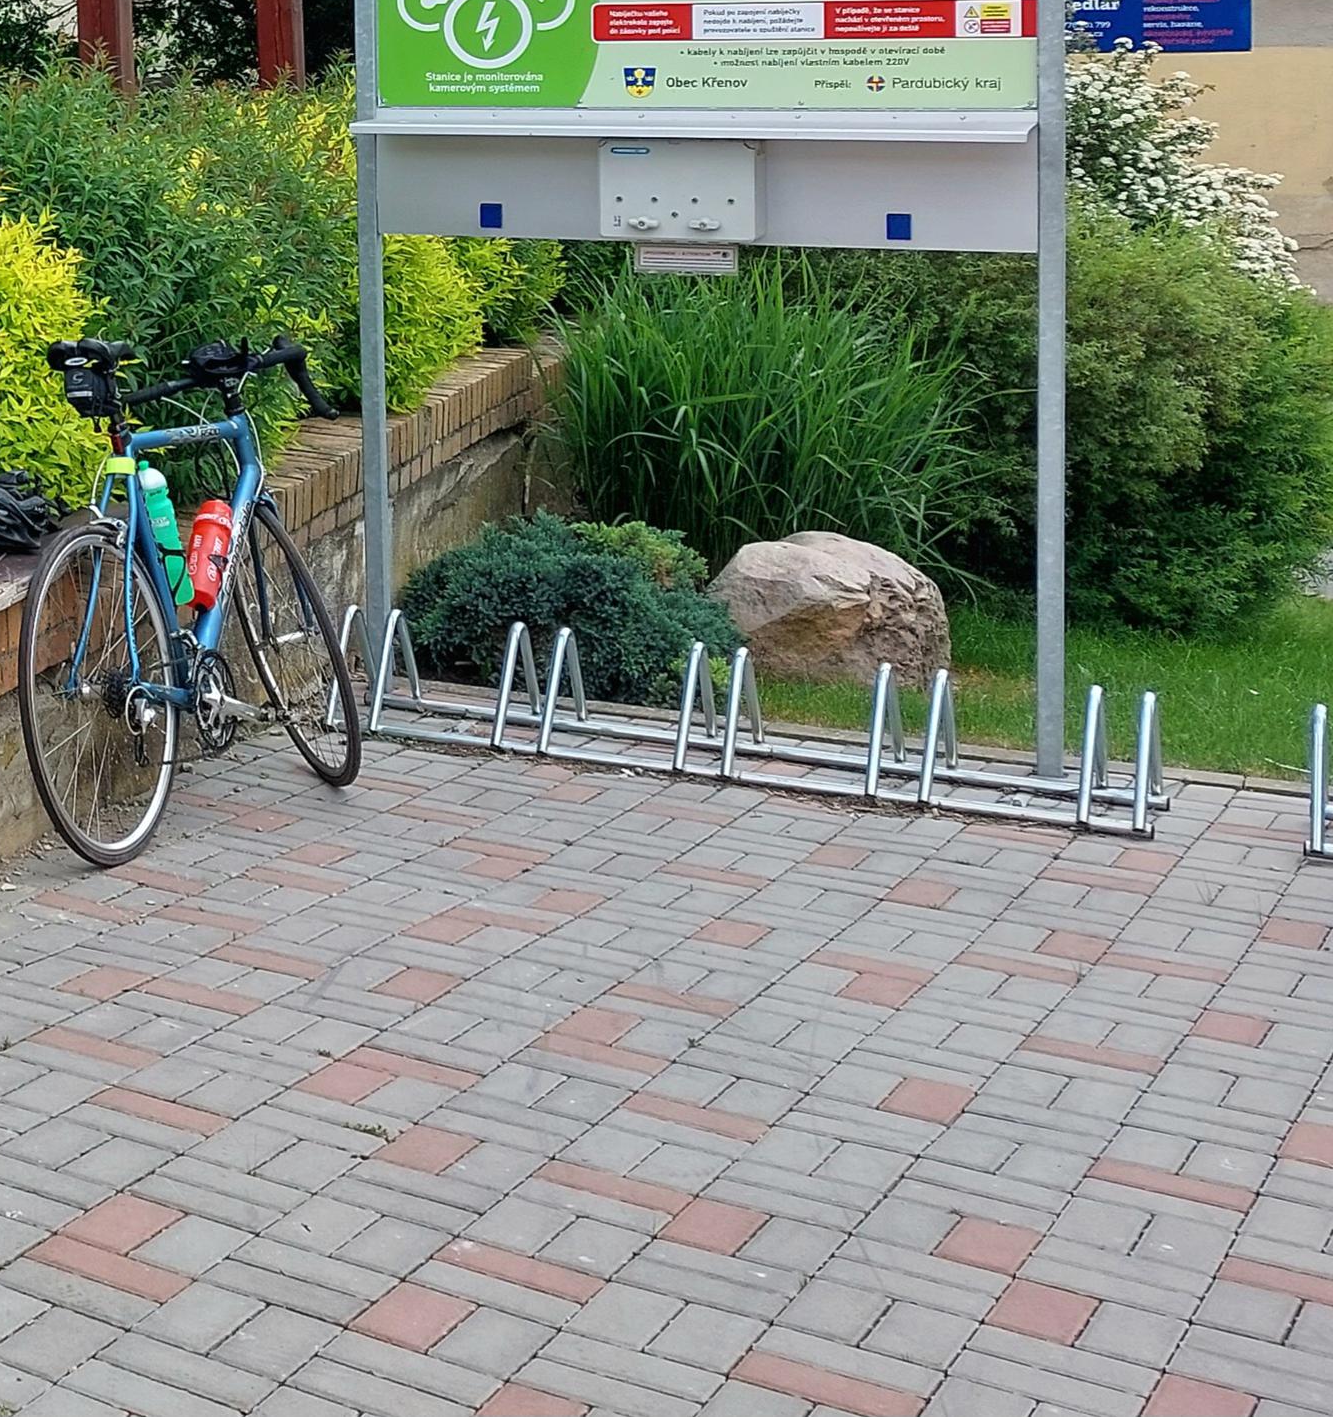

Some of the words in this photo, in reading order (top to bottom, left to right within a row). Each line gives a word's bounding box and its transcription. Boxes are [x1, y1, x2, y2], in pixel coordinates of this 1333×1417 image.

[687, 48, 717, 57] kabely
[727, 47, 763, 57] nabíjení
[765, 47, 779, 55] lze
[782, 47, 818, 56] zapůjčit
[828, 46, 868, 56] hospodě
[878, 46, 920, 55] otevírací
[922, 46, 946, 54] době
[761, 58, 797, 67] nabíjení
[800, 58, 840, 66] vlastním
[843, 58, 883, 66] kabelem
[886, 58, 910, 66] 220V
[425, 71, 462, 82] Stanice
[463, 71, 473, 83] je
[475, 70, 543, 81] monitorována
[666, 76, 698, 88] Obec
[701, 76, 748, 88] Křenov
[429, 83, 486, 94] kamerovým
[488, 83, 541, 94] systémem
[814, 79, 852, 90] Přispěl:
[892, 77, 970, 91] Pardubický
[975, 77, 1002, 91] kraj
